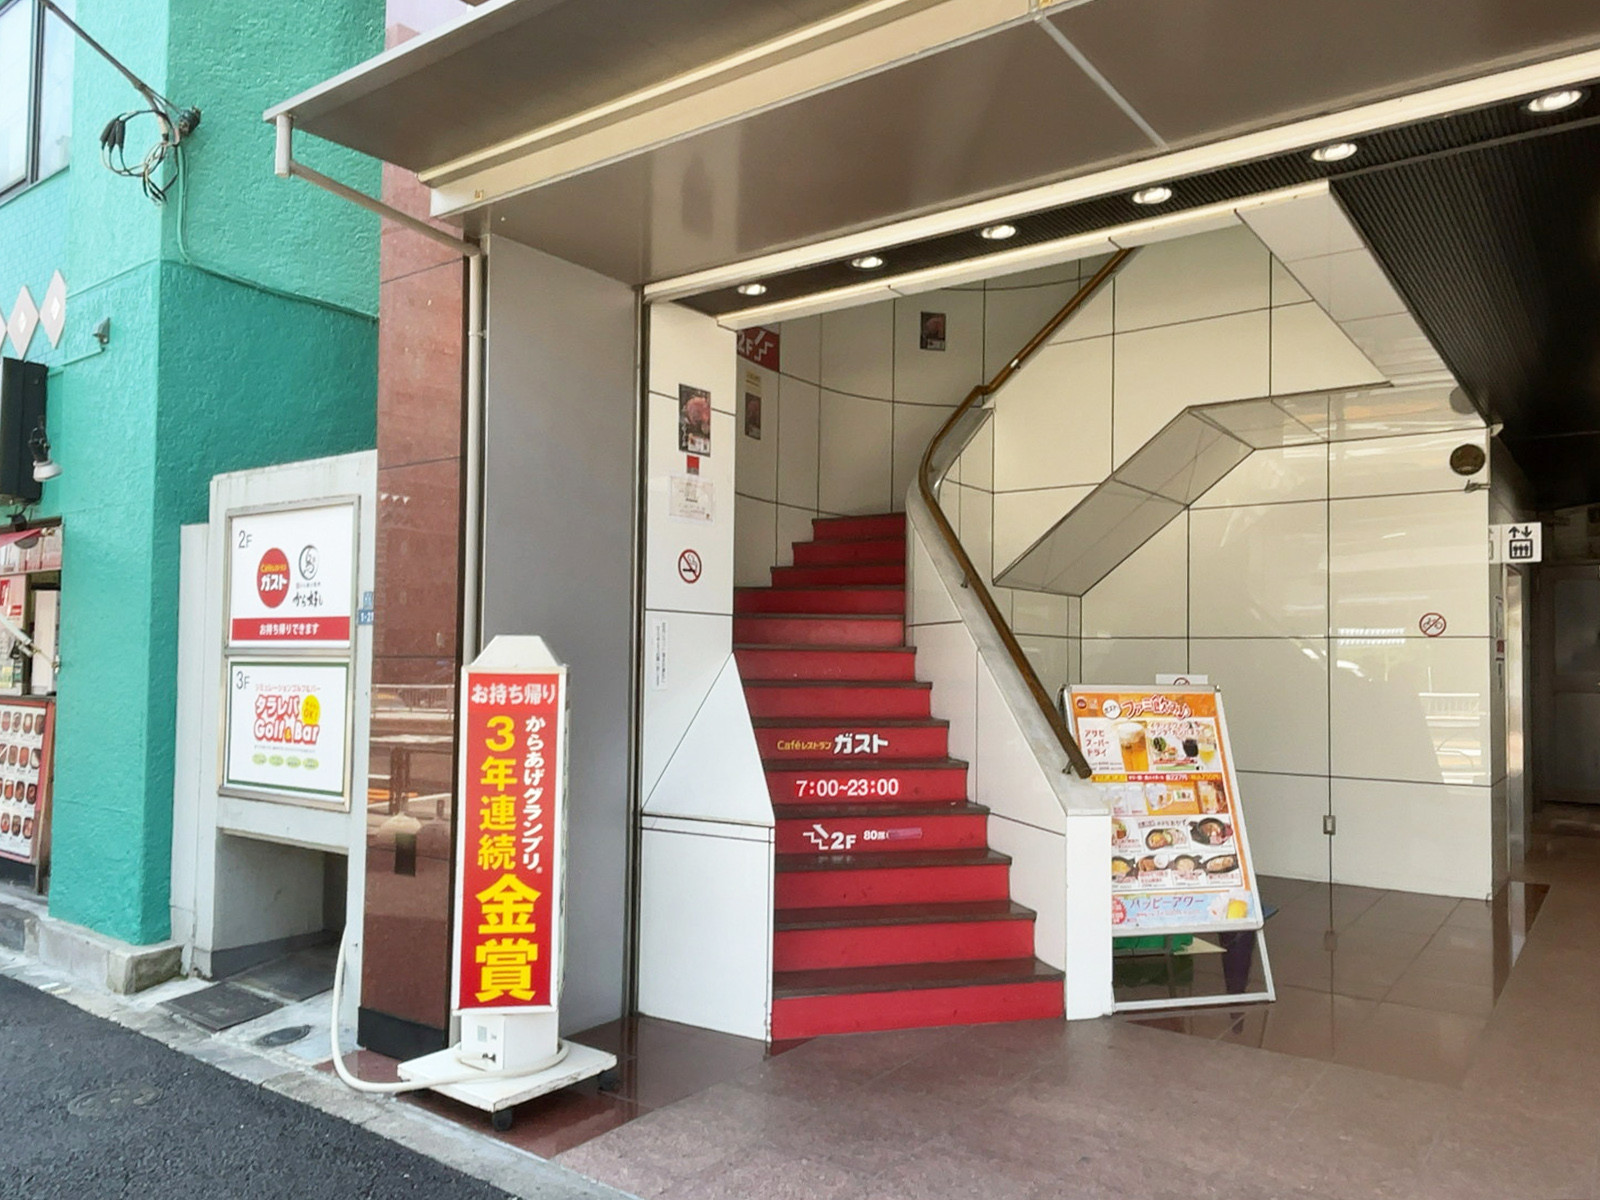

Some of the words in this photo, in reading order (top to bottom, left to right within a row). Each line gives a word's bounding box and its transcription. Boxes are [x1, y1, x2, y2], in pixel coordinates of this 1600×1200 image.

[238, 530, 252, 549] 2F
[260, 574, 288, 591] ガスト
[259, 623, 319, 636] お持ち帰りできます
[236, 671, 250, 690] 3F
[471, 683, 556, 705] お持ち帰り
[255, 694, 300, 718] タラレバ
[254, 718, 285, 742] Golf
[294, 720, 320, 745] Bar
[777, 740, 832, 751] Caféレストラン
[834, 733, 889, 754] ガスト
[830, 832, 857, 850] 2F
[1130, 896, 1204, 909] ハッピーアワー
